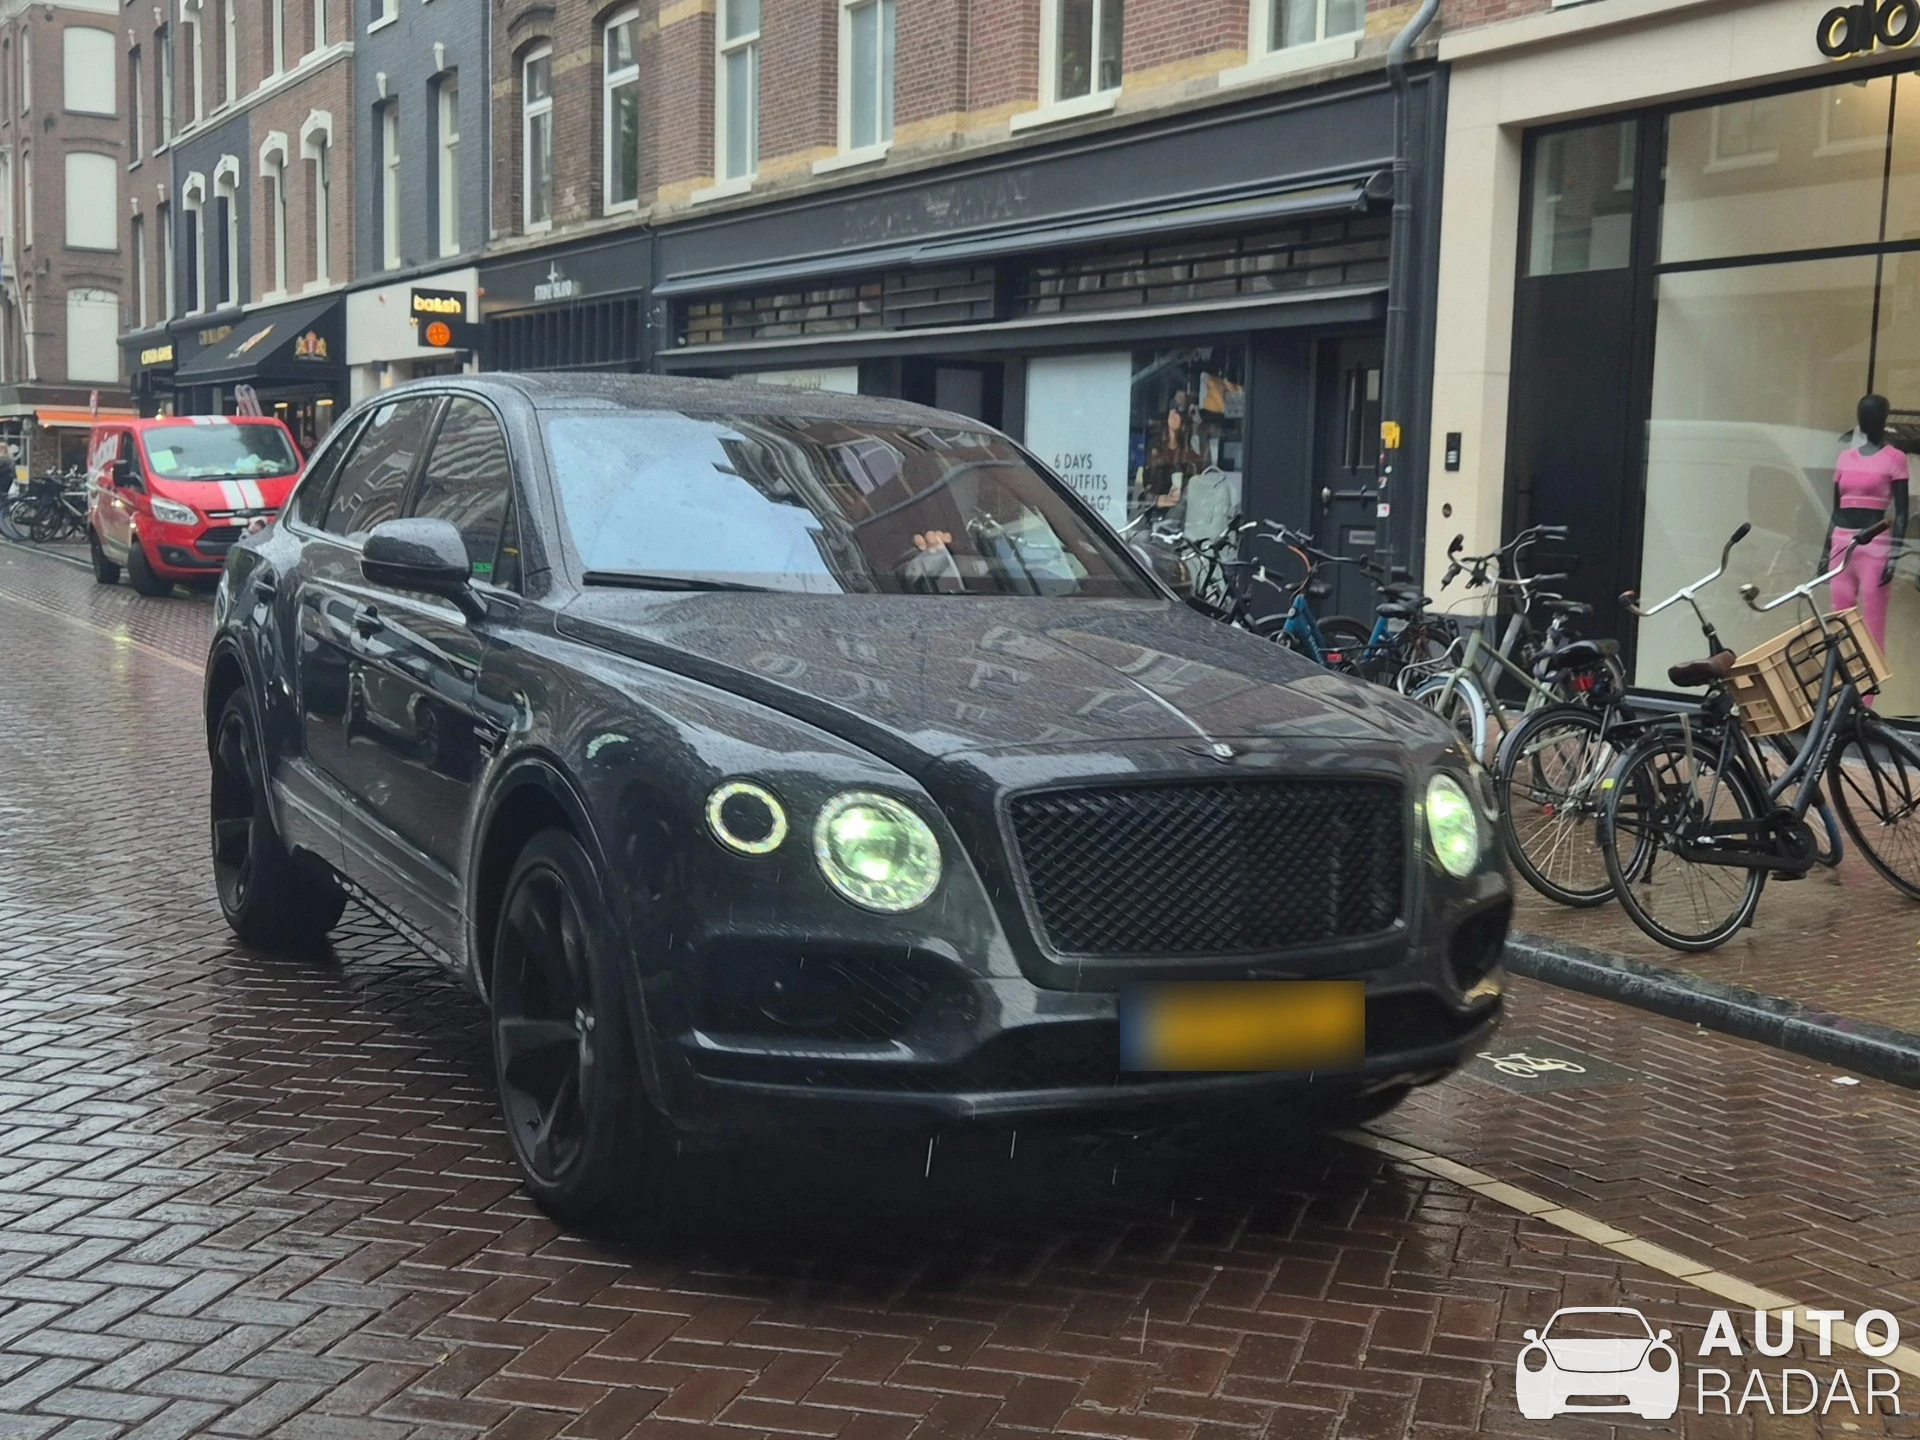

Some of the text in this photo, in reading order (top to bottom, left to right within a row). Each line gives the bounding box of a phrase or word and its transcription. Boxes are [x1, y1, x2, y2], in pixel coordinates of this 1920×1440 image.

[1816, 0, 1920, 57] alo
[1054, 453, 1093, 470] 6 DAYS
